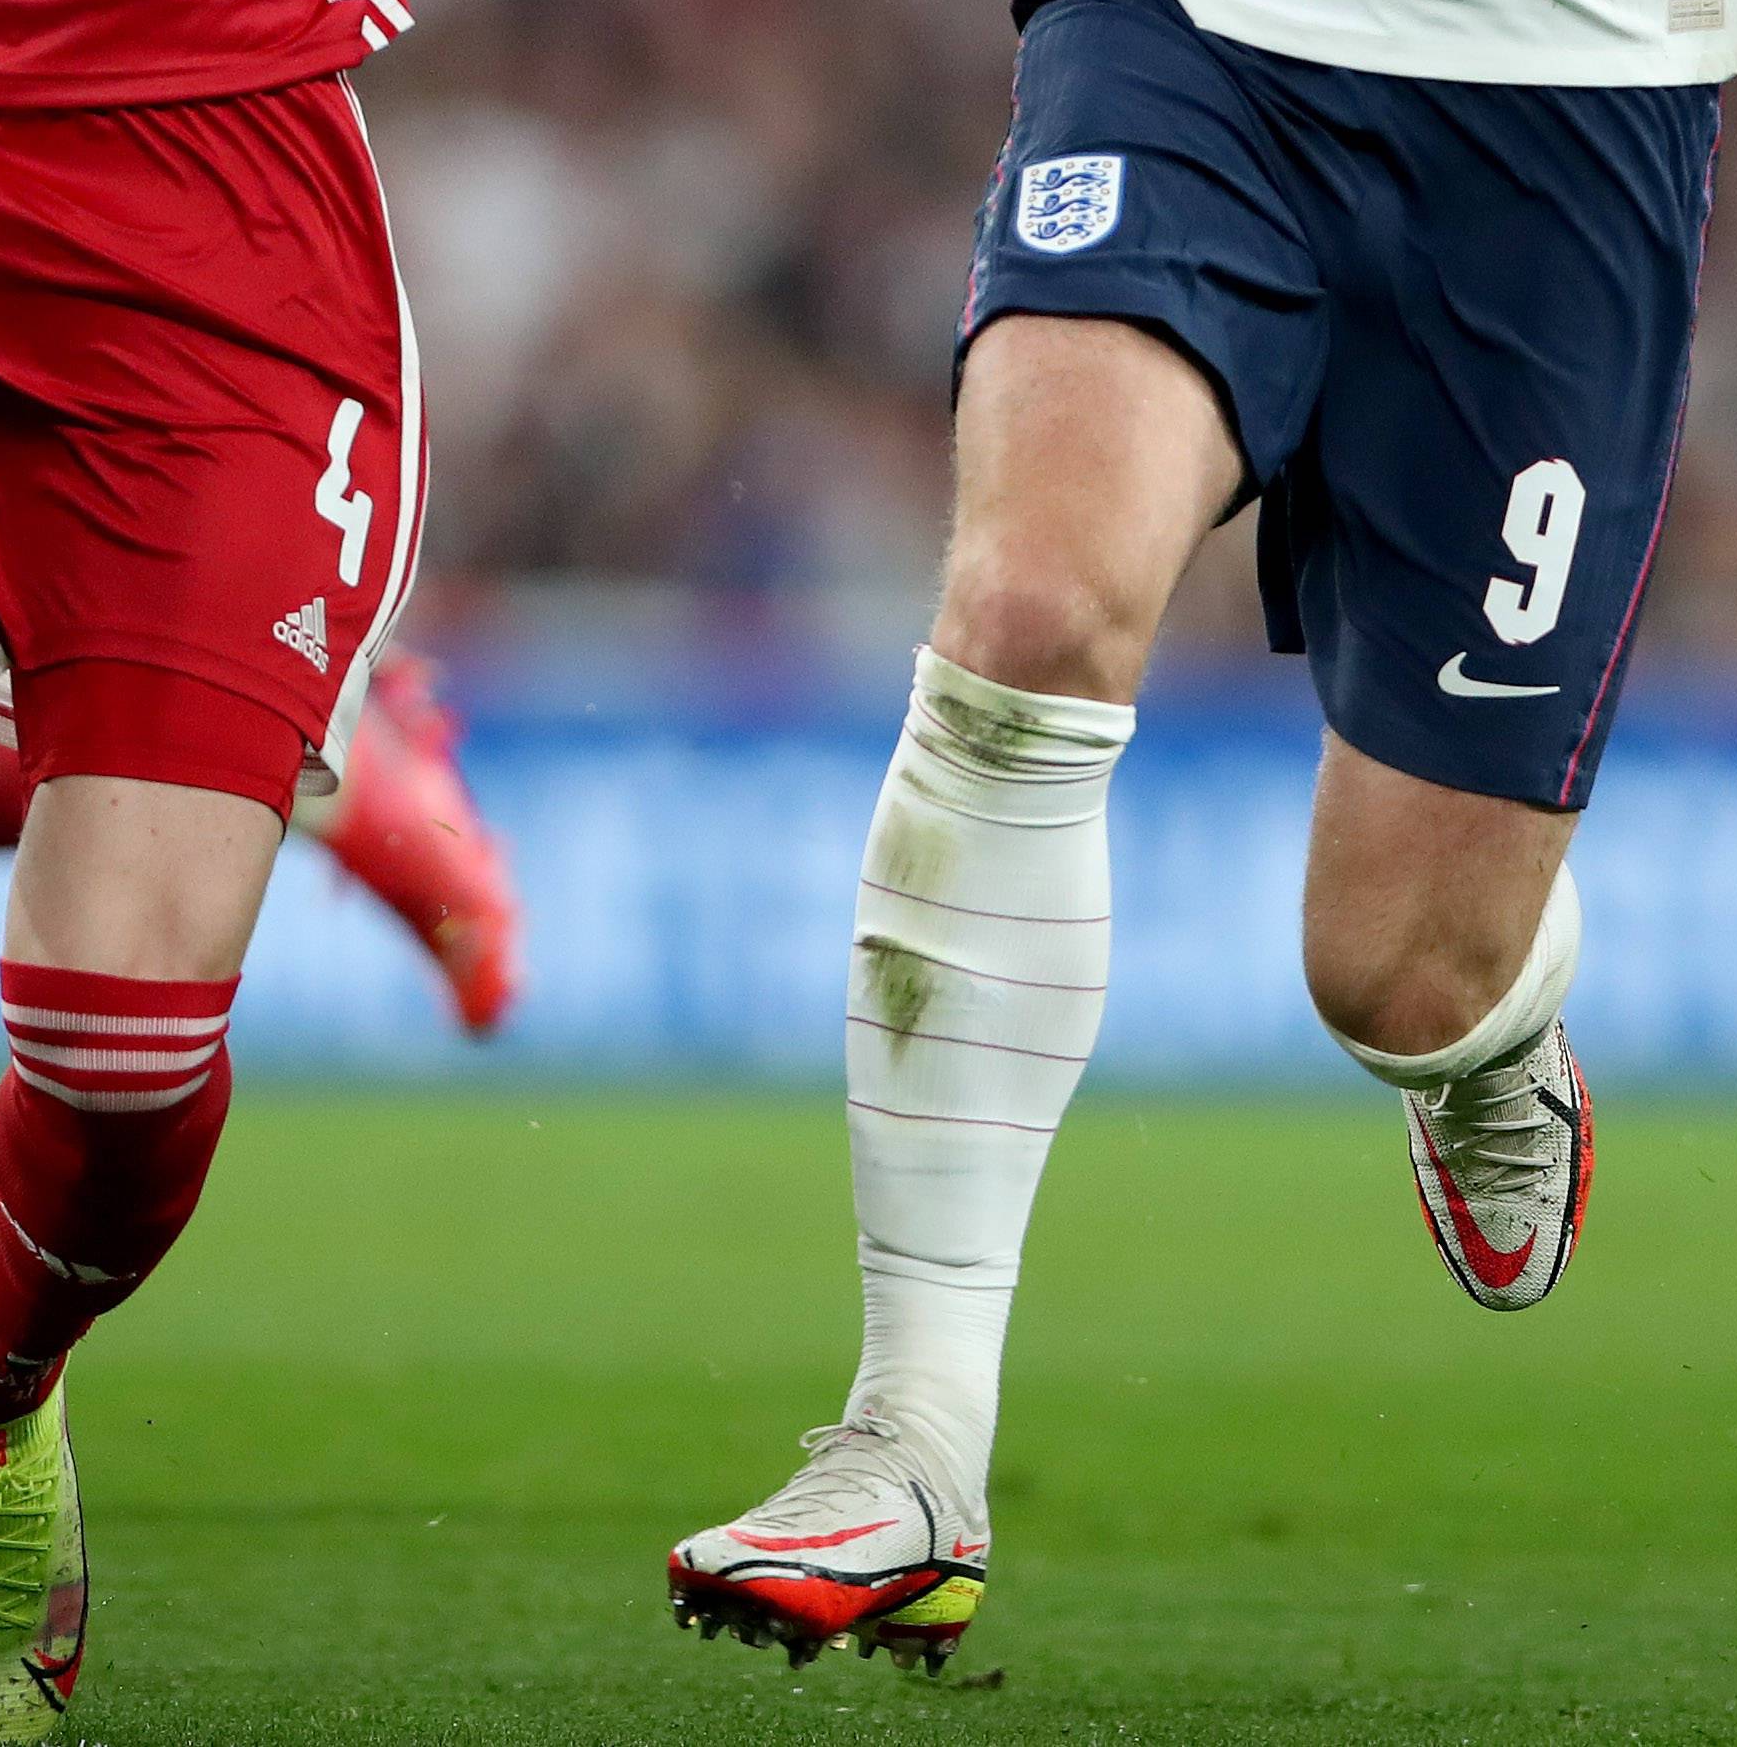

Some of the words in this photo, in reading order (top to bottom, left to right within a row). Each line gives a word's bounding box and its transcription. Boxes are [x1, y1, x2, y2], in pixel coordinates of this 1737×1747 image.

[314, 397, 373, 587] 4
[1482, 458, 1586, 646] 9
[273, 620, 329, 674] adidas
